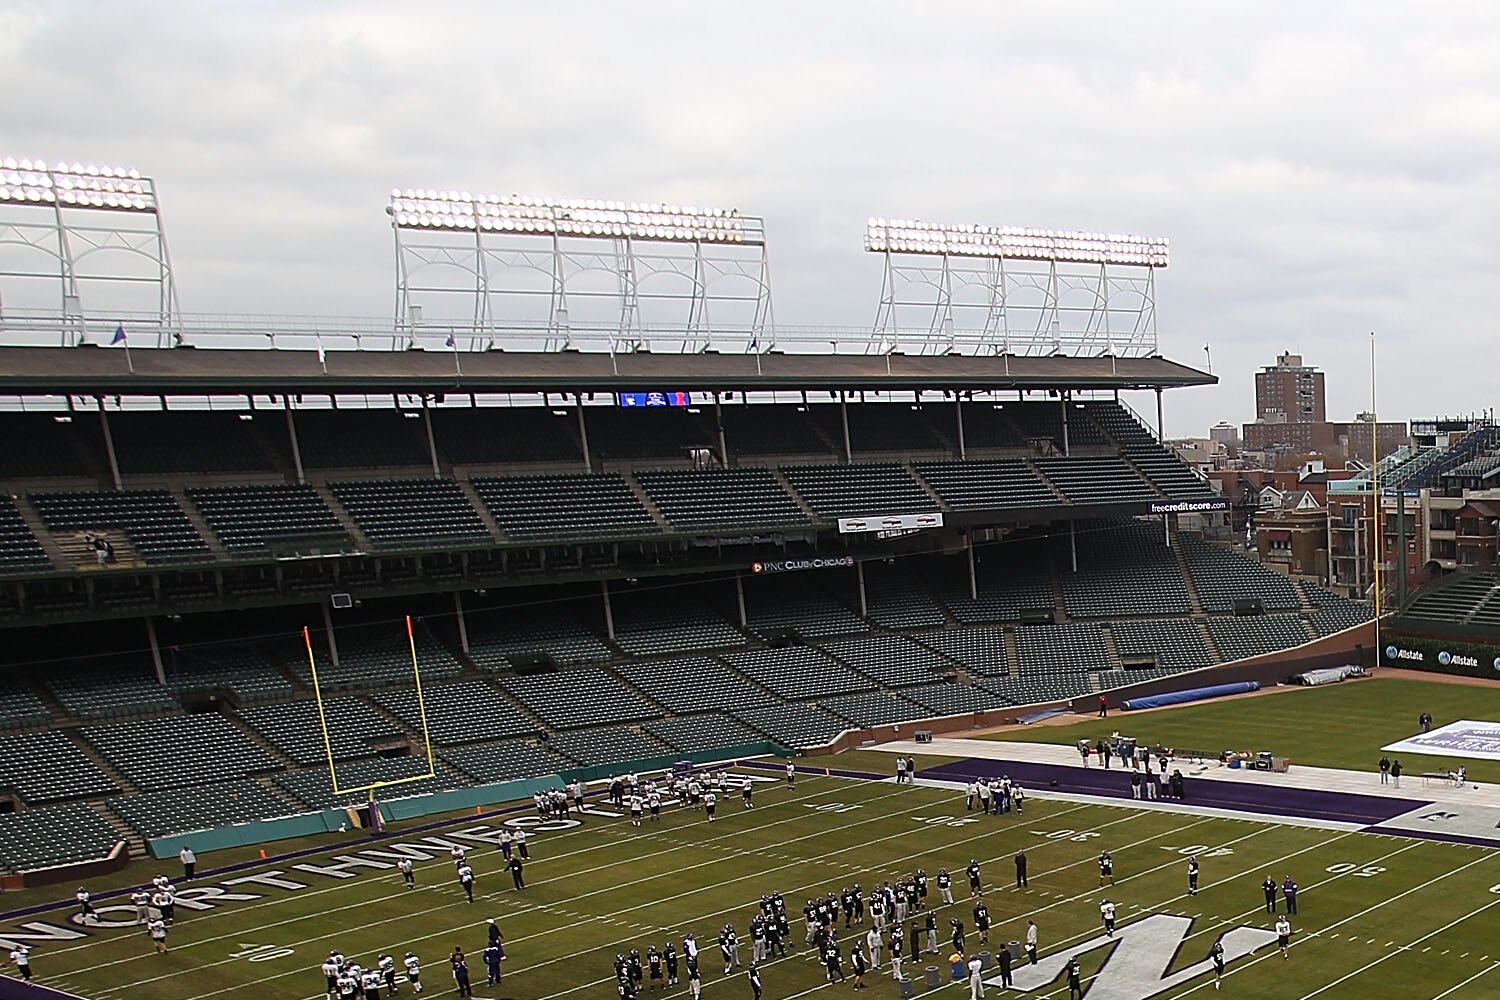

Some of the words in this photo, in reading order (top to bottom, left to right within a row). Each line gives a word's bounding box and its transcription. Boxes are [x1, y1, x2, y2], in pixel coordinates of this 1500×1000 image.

[1151, 502, 1226, 512] freecreditscore.com
[763, 562, 784, 571] PNC
[785, 561, 809, 569] CLUB
[813, 557, 852, 568] CHICAG
[1397, 649, 1424, 661] Allstate
[1450, 655, 1478, 667] Allstate
[814, 801, 863, 814] 10
[933, 815, 980, 828] 20
[1045, 829, 1101, 843] 30
[1178, 844, 1235, 858] 40
[1325, 863, 1387, 878] 50
[979, 909, 987, 918] 51
[229, 944, 295, 962] 10
[650, 954, 659, 963] 10
